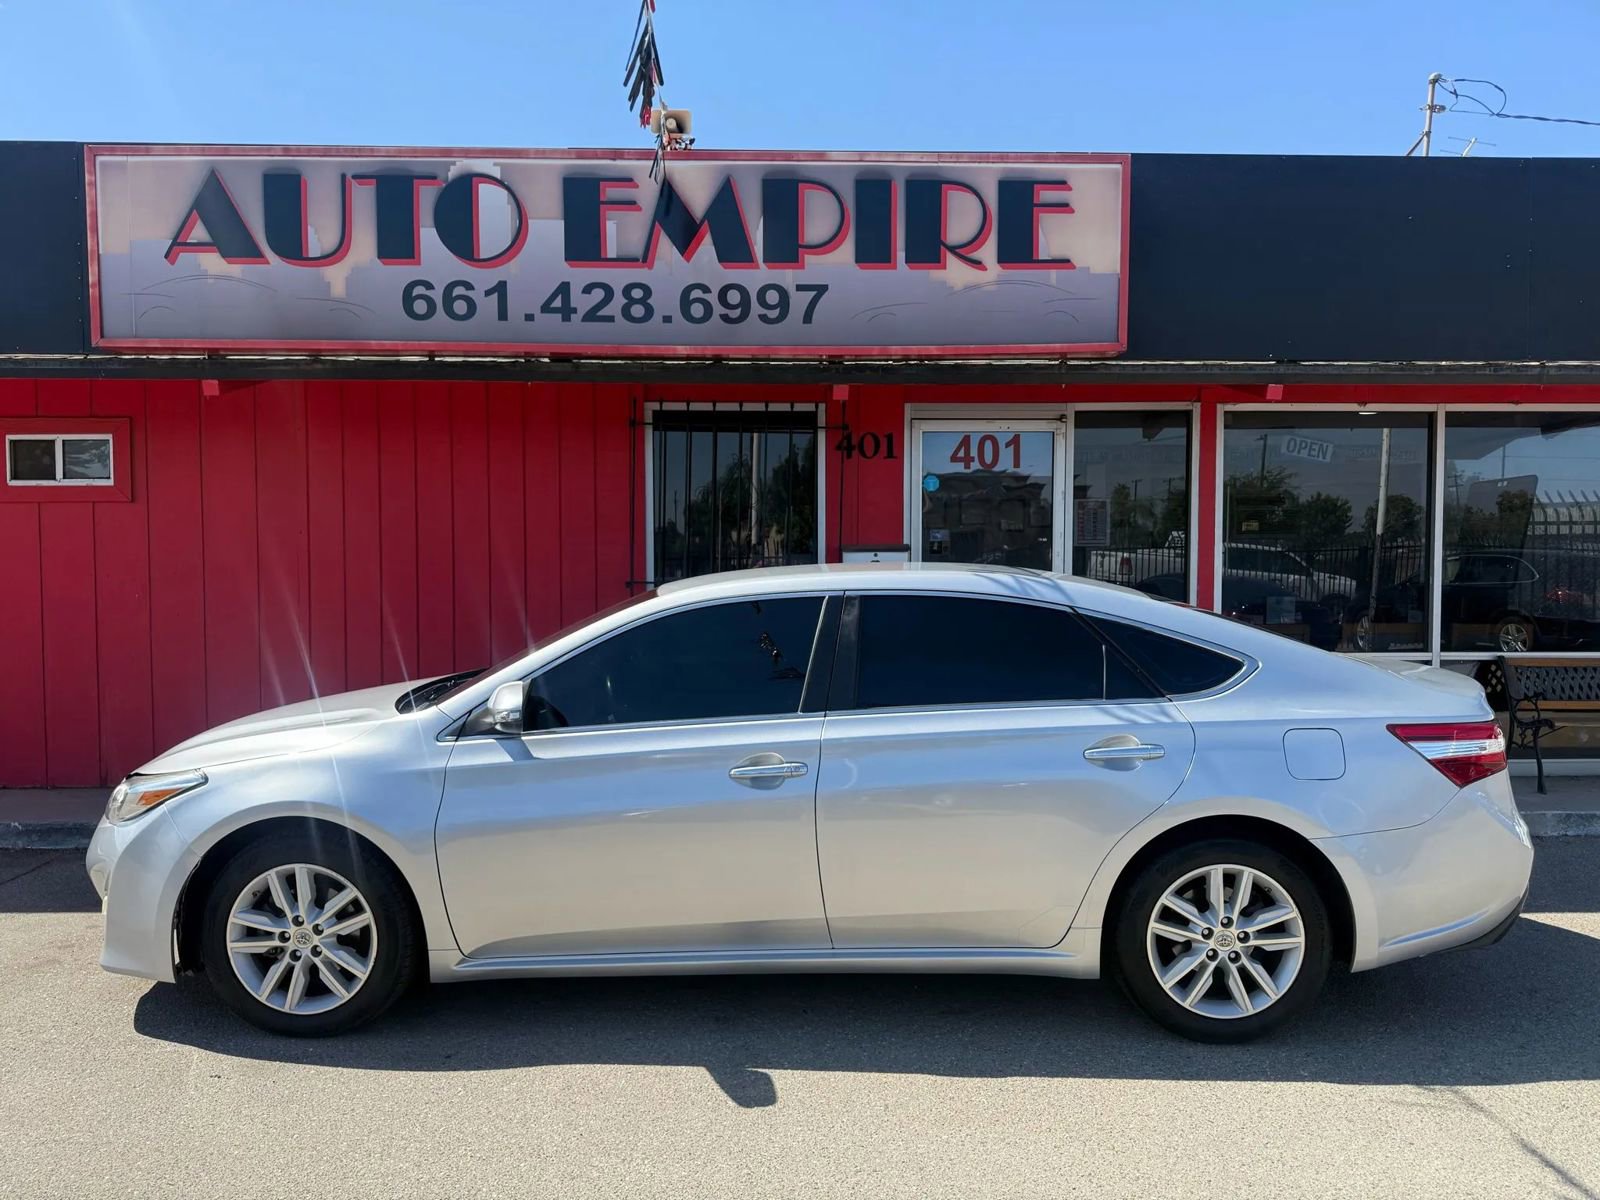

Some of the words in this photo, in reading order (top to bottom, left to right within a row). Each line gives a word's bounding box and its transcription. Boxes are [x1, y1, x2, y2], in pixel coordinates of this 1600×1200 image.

[164, 168, 529, 268] AUTO
[564, 175, 1077, 271] EMPIRE
[402, 279, 830, 325] 661.428.6997
[835, 432, 898, 459] 401
[950, 433, 1021, 470] 401
[1286, 437, 1329, 460] OPEN
